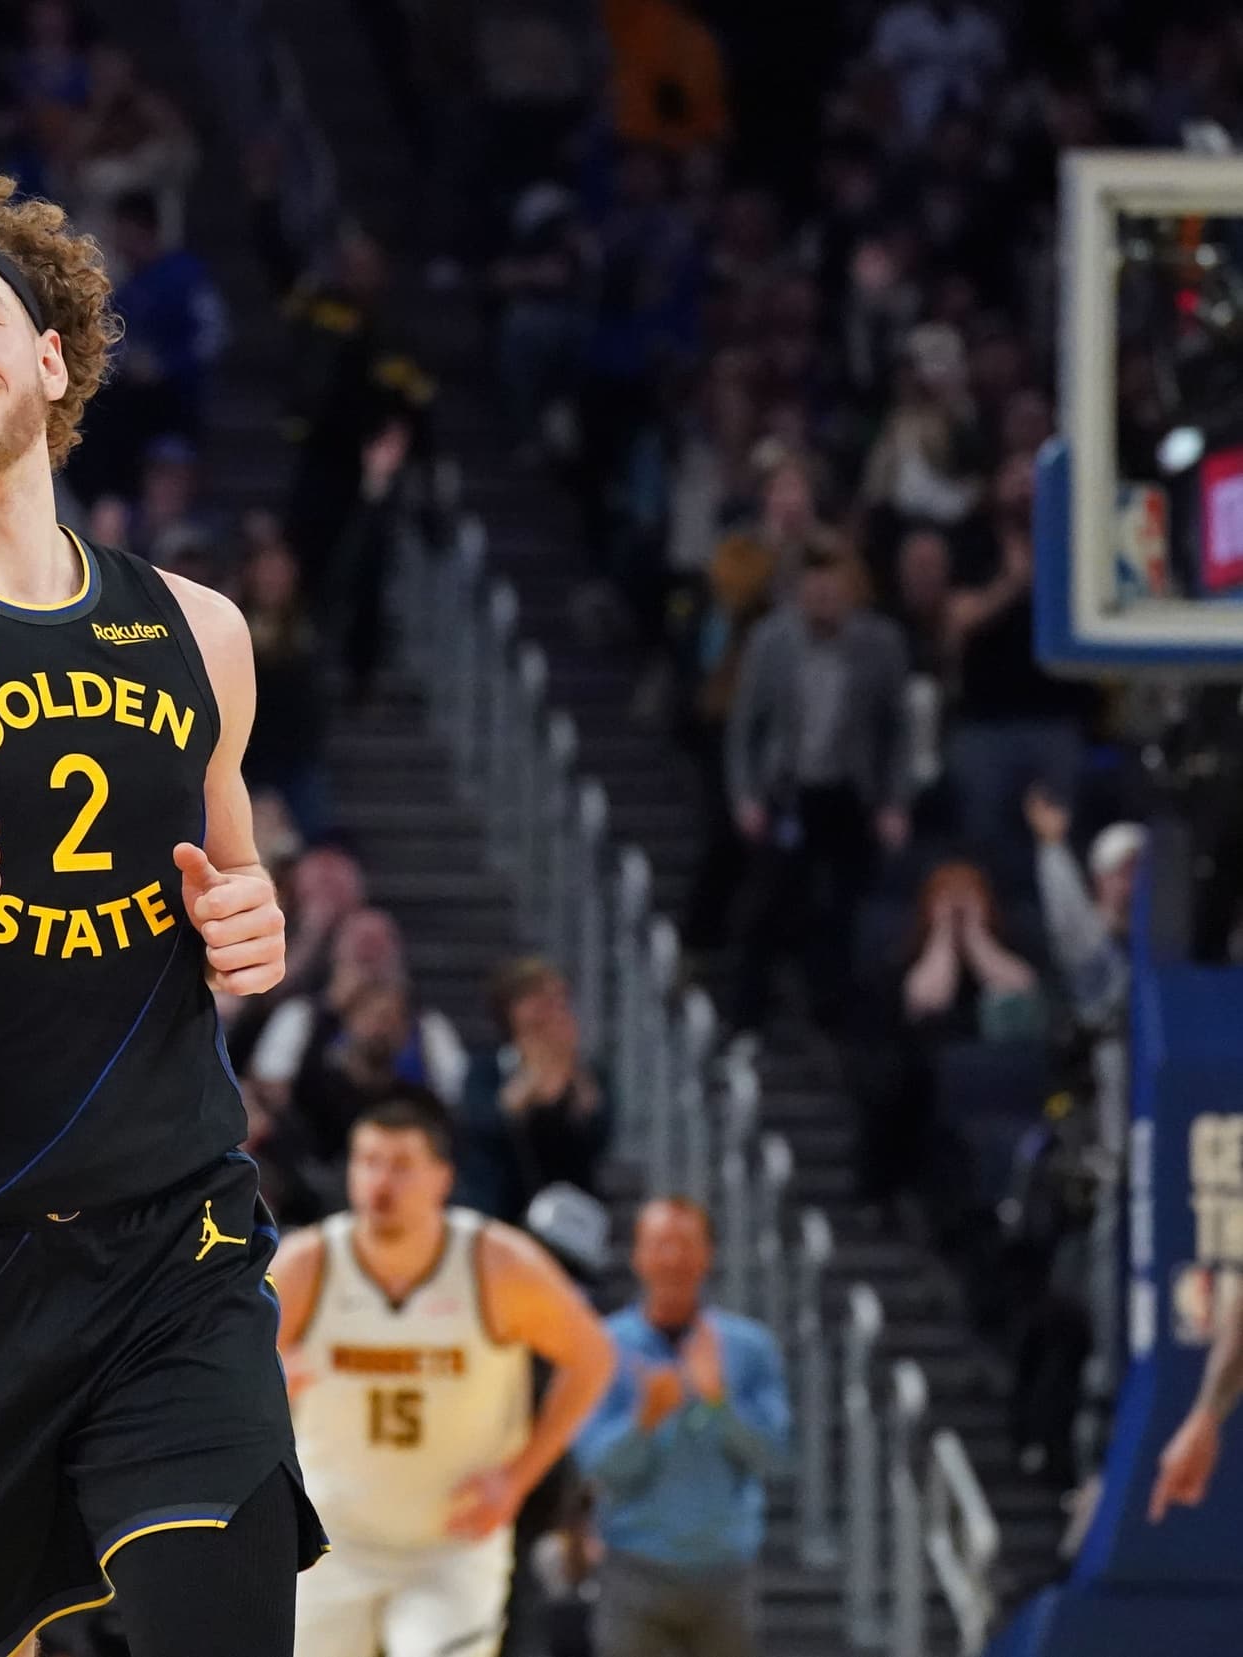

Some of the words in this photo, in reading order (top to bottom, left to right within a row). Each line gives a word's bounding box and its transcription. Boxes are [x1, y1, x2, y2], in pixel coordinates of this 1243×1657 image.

[92, 622, 168, 640] Rakuten
[50, 753, 113, 872] 2
[369, 1386, 424, 1447] 15
